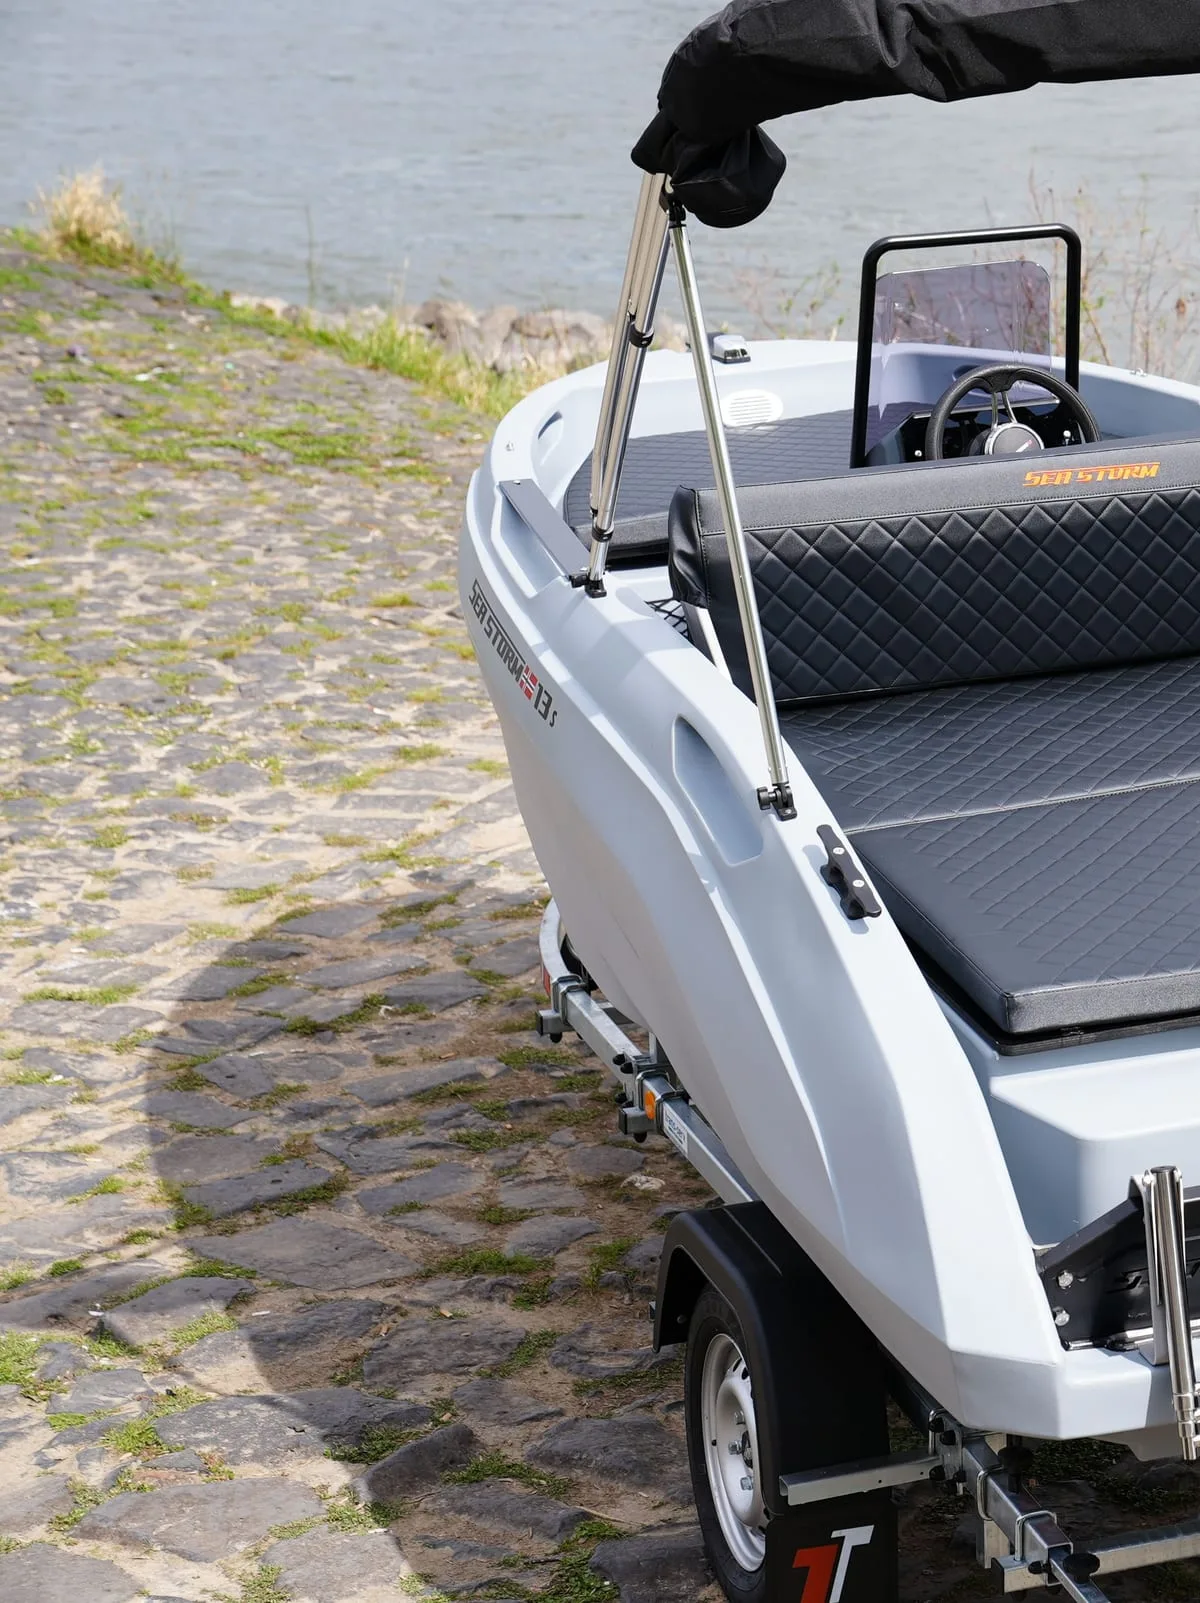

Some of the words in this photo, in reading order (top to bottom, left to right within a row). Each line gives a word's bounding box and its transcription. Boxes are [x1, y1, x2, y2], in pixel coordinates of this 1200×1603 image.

[1023, 470, 1072, 487] SEA
[1075, 462, 1160, 482] STORM
[468, 579, 489, 625] SEA
[484, 614, 526, 683] STORM
